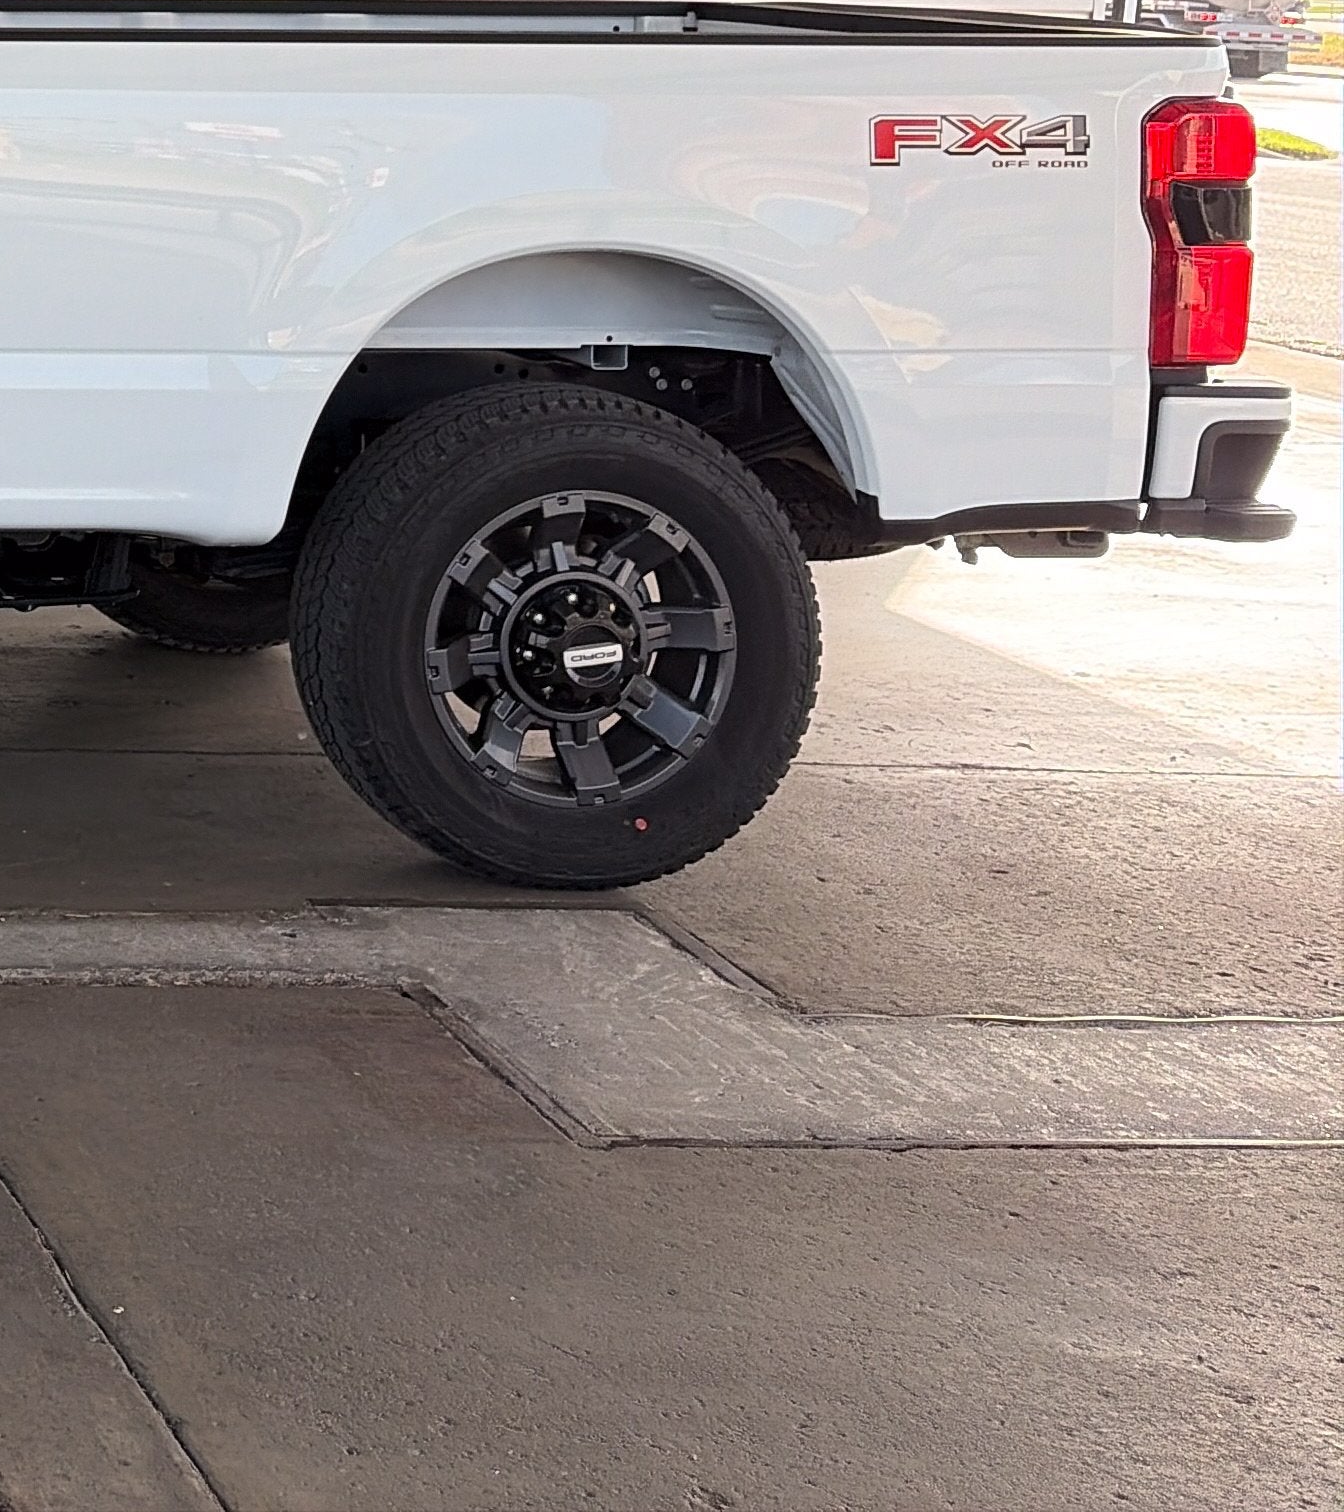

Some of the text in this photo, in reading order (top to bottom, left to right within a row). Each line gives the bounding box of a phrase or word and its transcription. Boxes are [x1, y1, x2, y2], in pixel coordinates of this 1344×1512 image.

[869, 115, 1090, 166] FX4
[992, 160, 1088, 169] OFF ROAD
[571, 651, 616, 662] FORD
